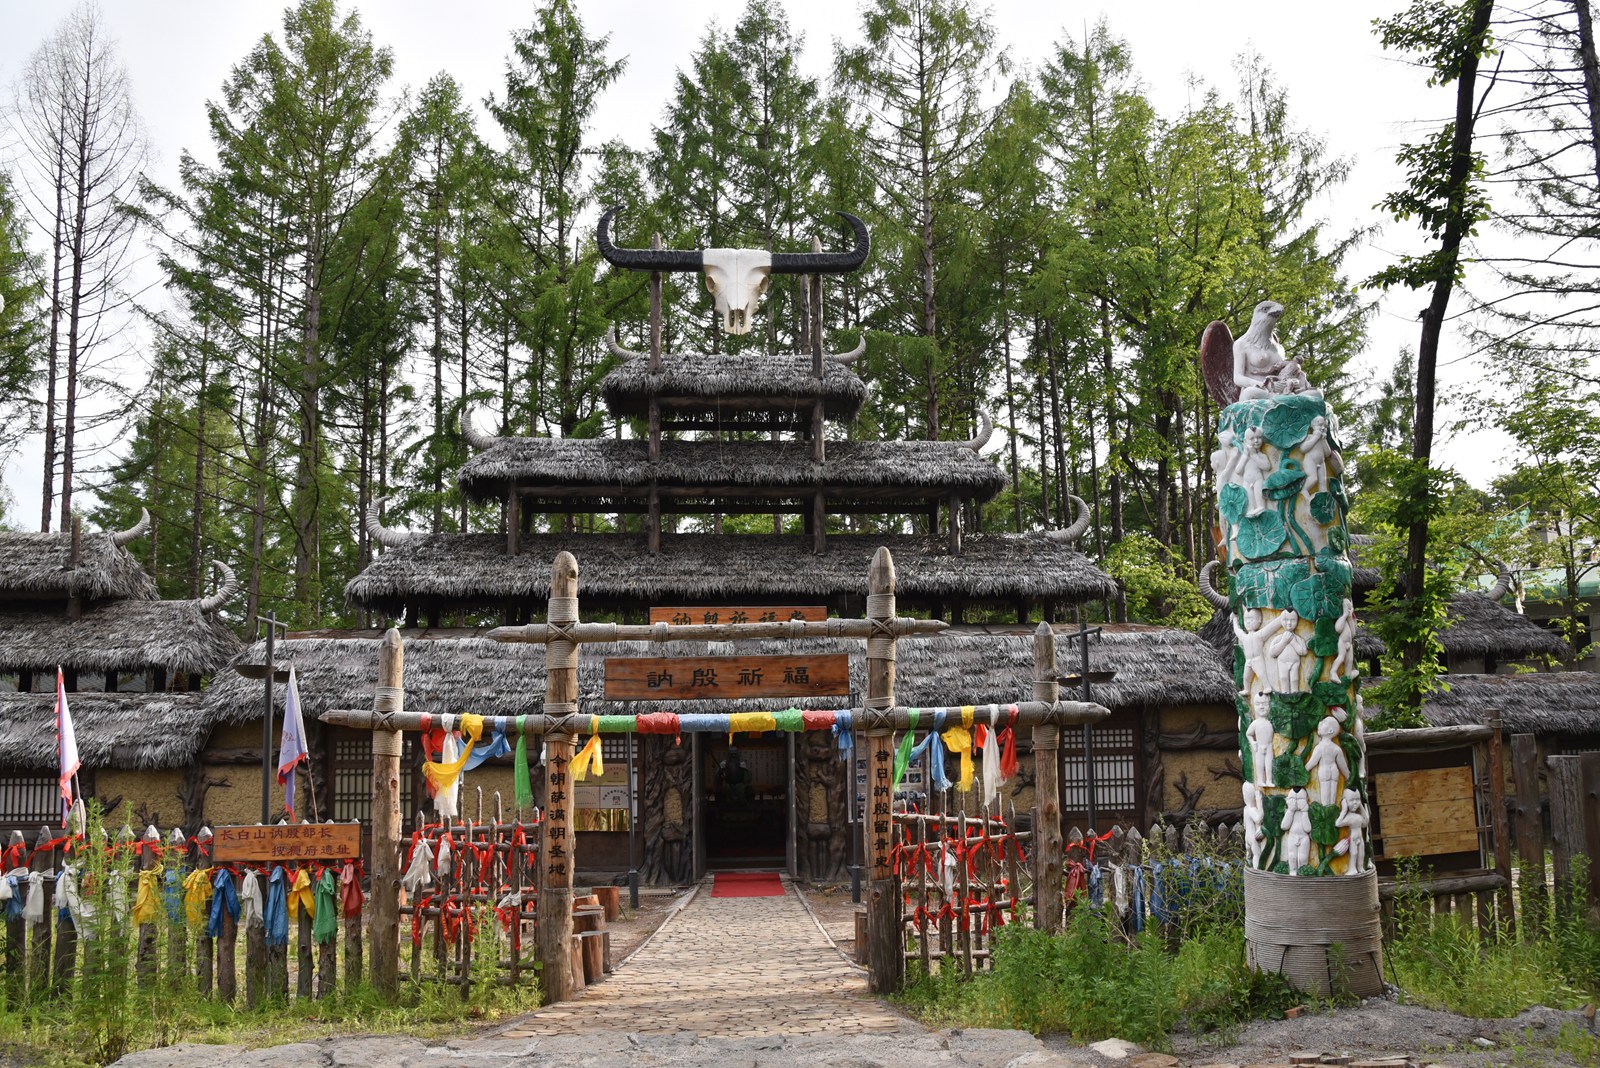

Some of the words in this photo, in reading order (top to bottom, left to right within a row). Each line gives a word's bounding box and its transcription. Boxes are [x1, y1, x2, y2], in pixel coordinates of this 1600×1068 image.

[646, 667, 810, 688] 訥殷祈福
[220, 827, 332, 841] 长白山讷殷部长
